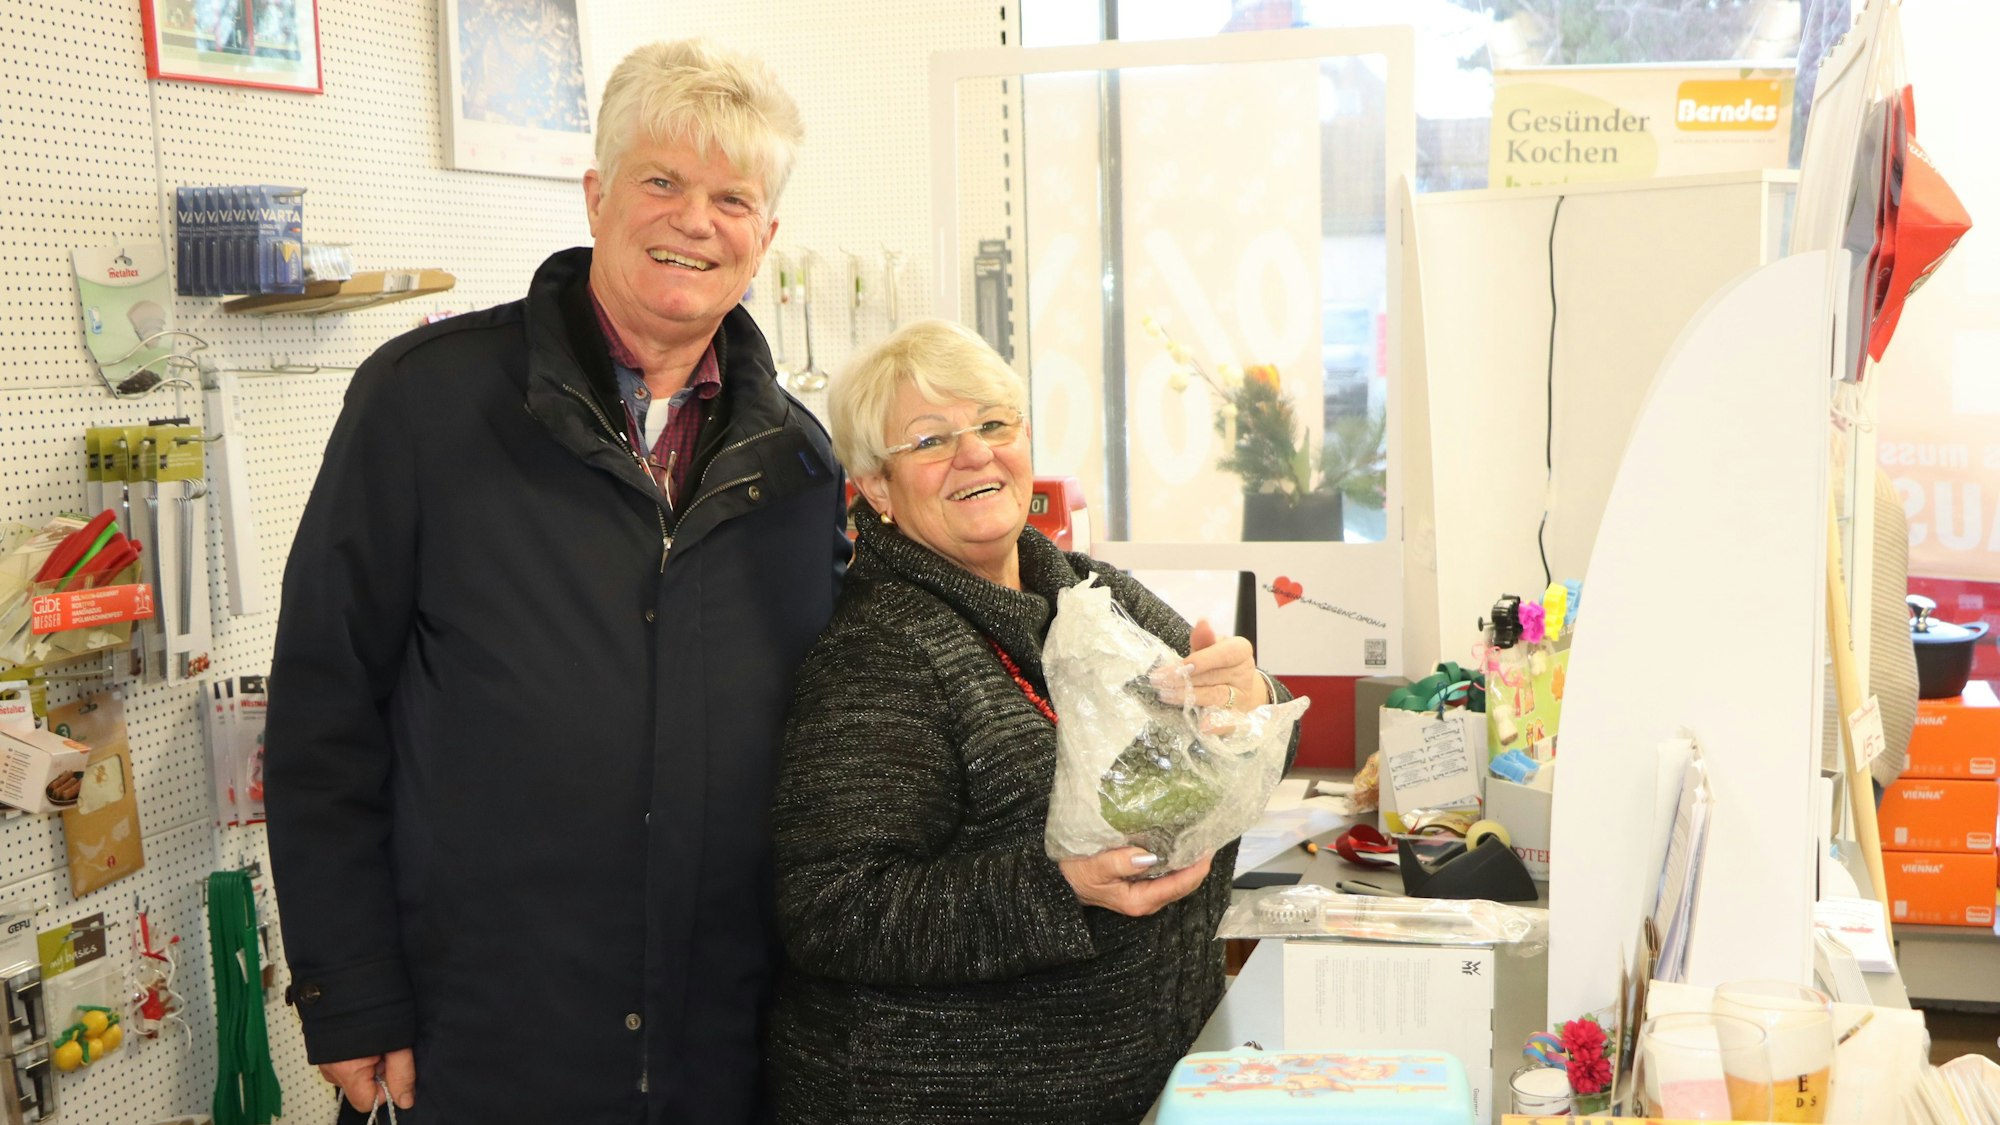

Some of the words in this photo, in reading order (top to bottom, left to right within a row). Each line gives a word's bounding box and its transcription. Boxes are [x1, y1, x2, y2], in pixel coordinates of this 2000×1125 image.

[1678, 98, 1777, 122] Berndes
[1507, 108, 1650, 133] Gesünder
[1506, 139, 1619, 163] Kochen
[261, 207, 301, 223] VARTA
[33, 596, 61, 615] GÜDE
[33, 612, 62, 630] MESSER
[8, 919, 31, 934] GEFU
[66, 944, 97, 962] basics
